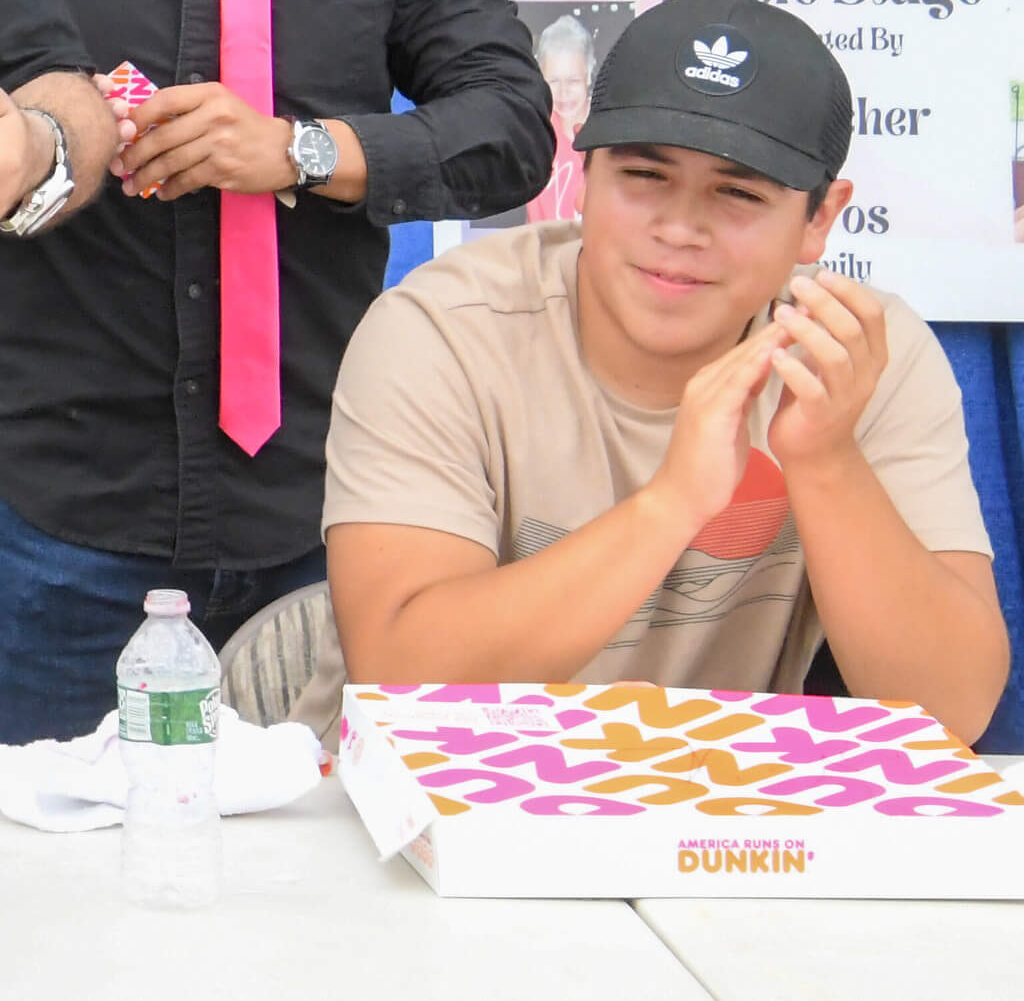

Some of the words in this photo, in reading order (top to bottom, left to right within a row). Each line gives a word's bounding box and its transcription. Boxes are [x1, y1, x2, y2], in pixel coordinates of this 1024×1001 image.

[817, 27, 863, 51] ted
[871, 27, 904, 57] By
[685, 66, 740, 88] adidas
[852, 97, 931, 136] her
[843, 206, 889, 234] os
[678, 839, 739, 849] AMERICA
[744, 839, 779, 849] RUNS
[784, 839, 805, 849] ON
[678, 849, 814, 873] DUNKIN'
